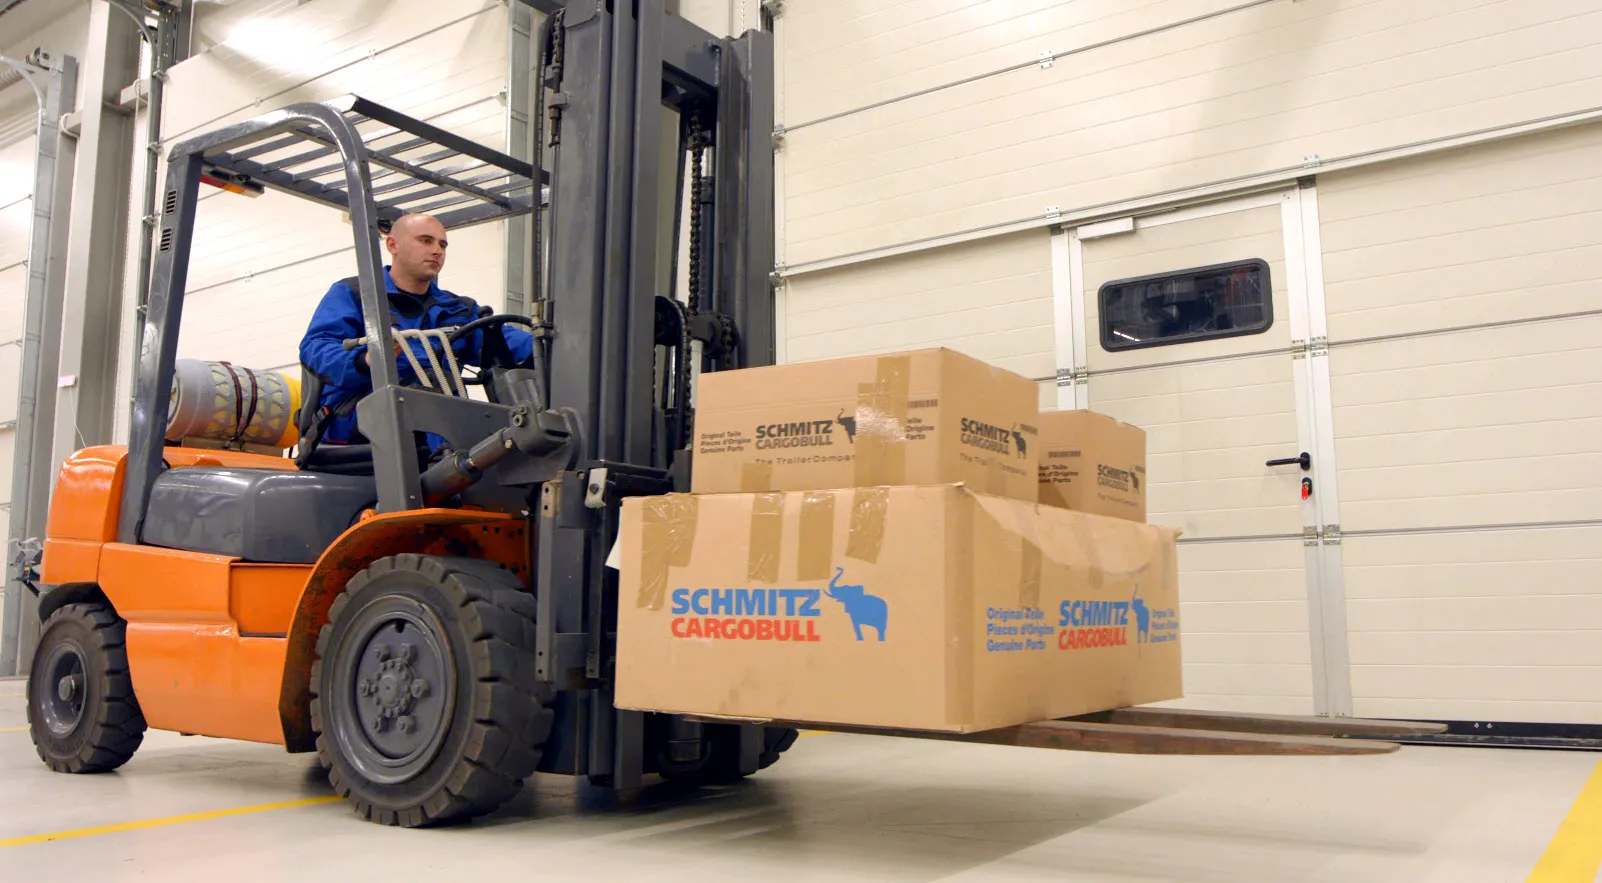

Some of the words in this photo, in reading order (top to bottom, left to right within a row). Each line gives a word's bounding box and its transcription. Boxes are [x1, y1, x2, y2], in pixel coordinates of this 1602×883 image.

[756, 419, 833, 439] SCHMITZ
[961, 417, 1010, 444] SCHMITZ
[756, 434, 833, 450] CARGOBULL
[960, 432, 1009, 456] CARGOBULL
[1097, 464, 1129, 483] SCHMITZ
[671, 588, 821, 617] SCHMITZ
[986, 607, 1023, 622] Original
[1058, 600, 1129, 627] SCHMITZ
[671, 617, 821, 642] CARGOBULL
[1058, 626, 1128, 651] CARGOBULL
[986, 639, 1023, 652] Genuine
